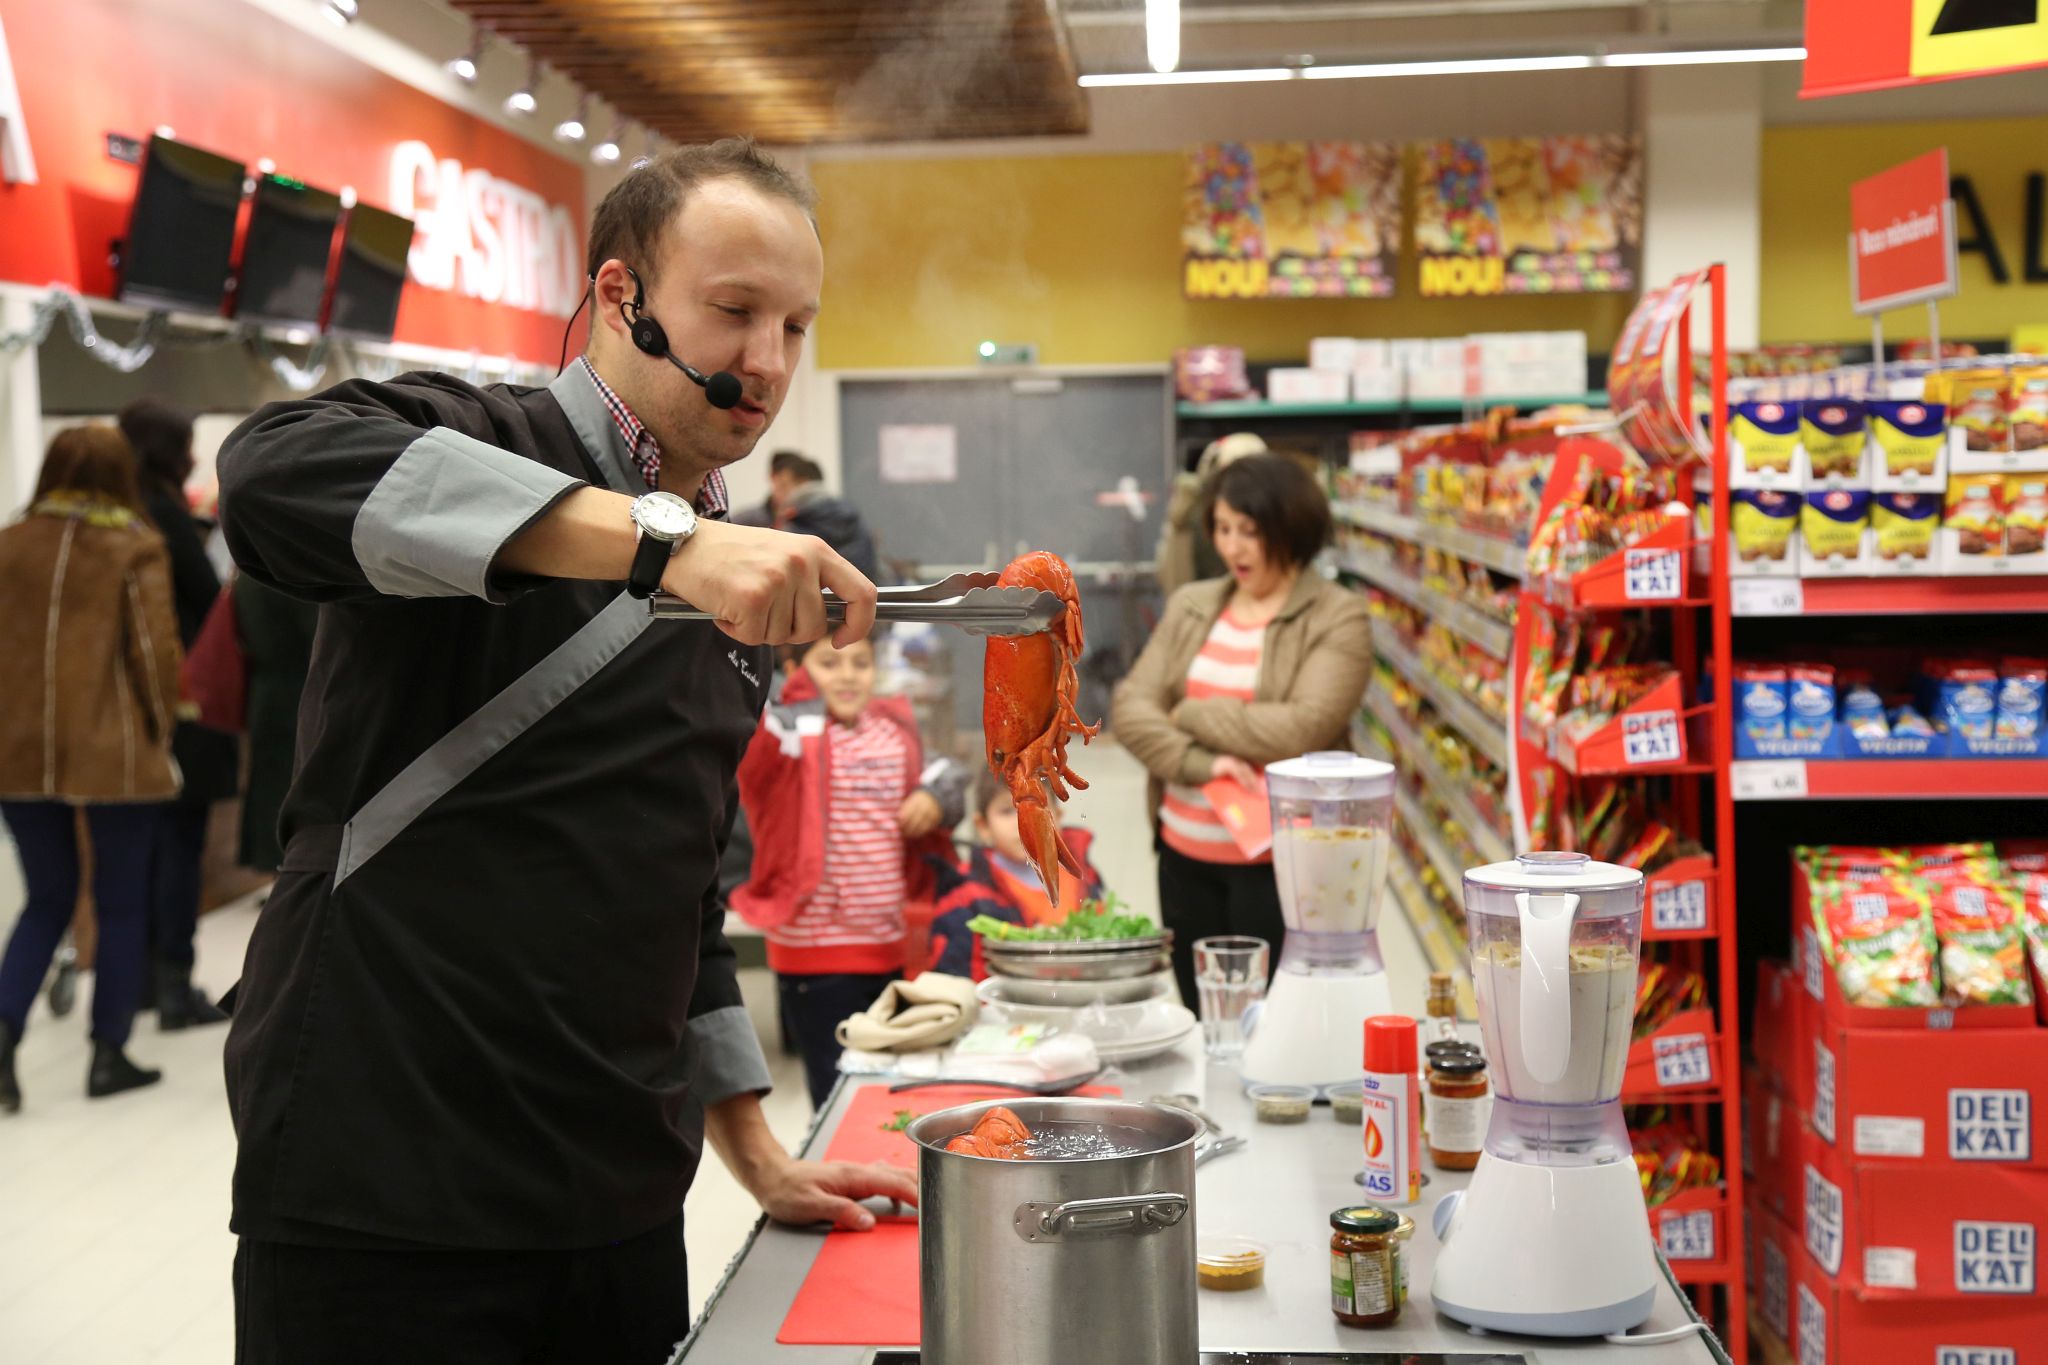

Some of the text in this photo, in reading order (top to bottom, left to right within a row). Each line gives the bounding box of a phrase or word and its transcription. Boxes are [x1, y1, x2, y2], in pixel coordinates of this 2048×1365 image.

[388, 138, 581, 318] GASTRO
[1185, 258, 1269, 298] NOU!
[1419, 256, 1505, 297] NOU!
[1956, 1096, 2022, 1121] DELI
[1961, 1227, 2028, 1254] DELI
